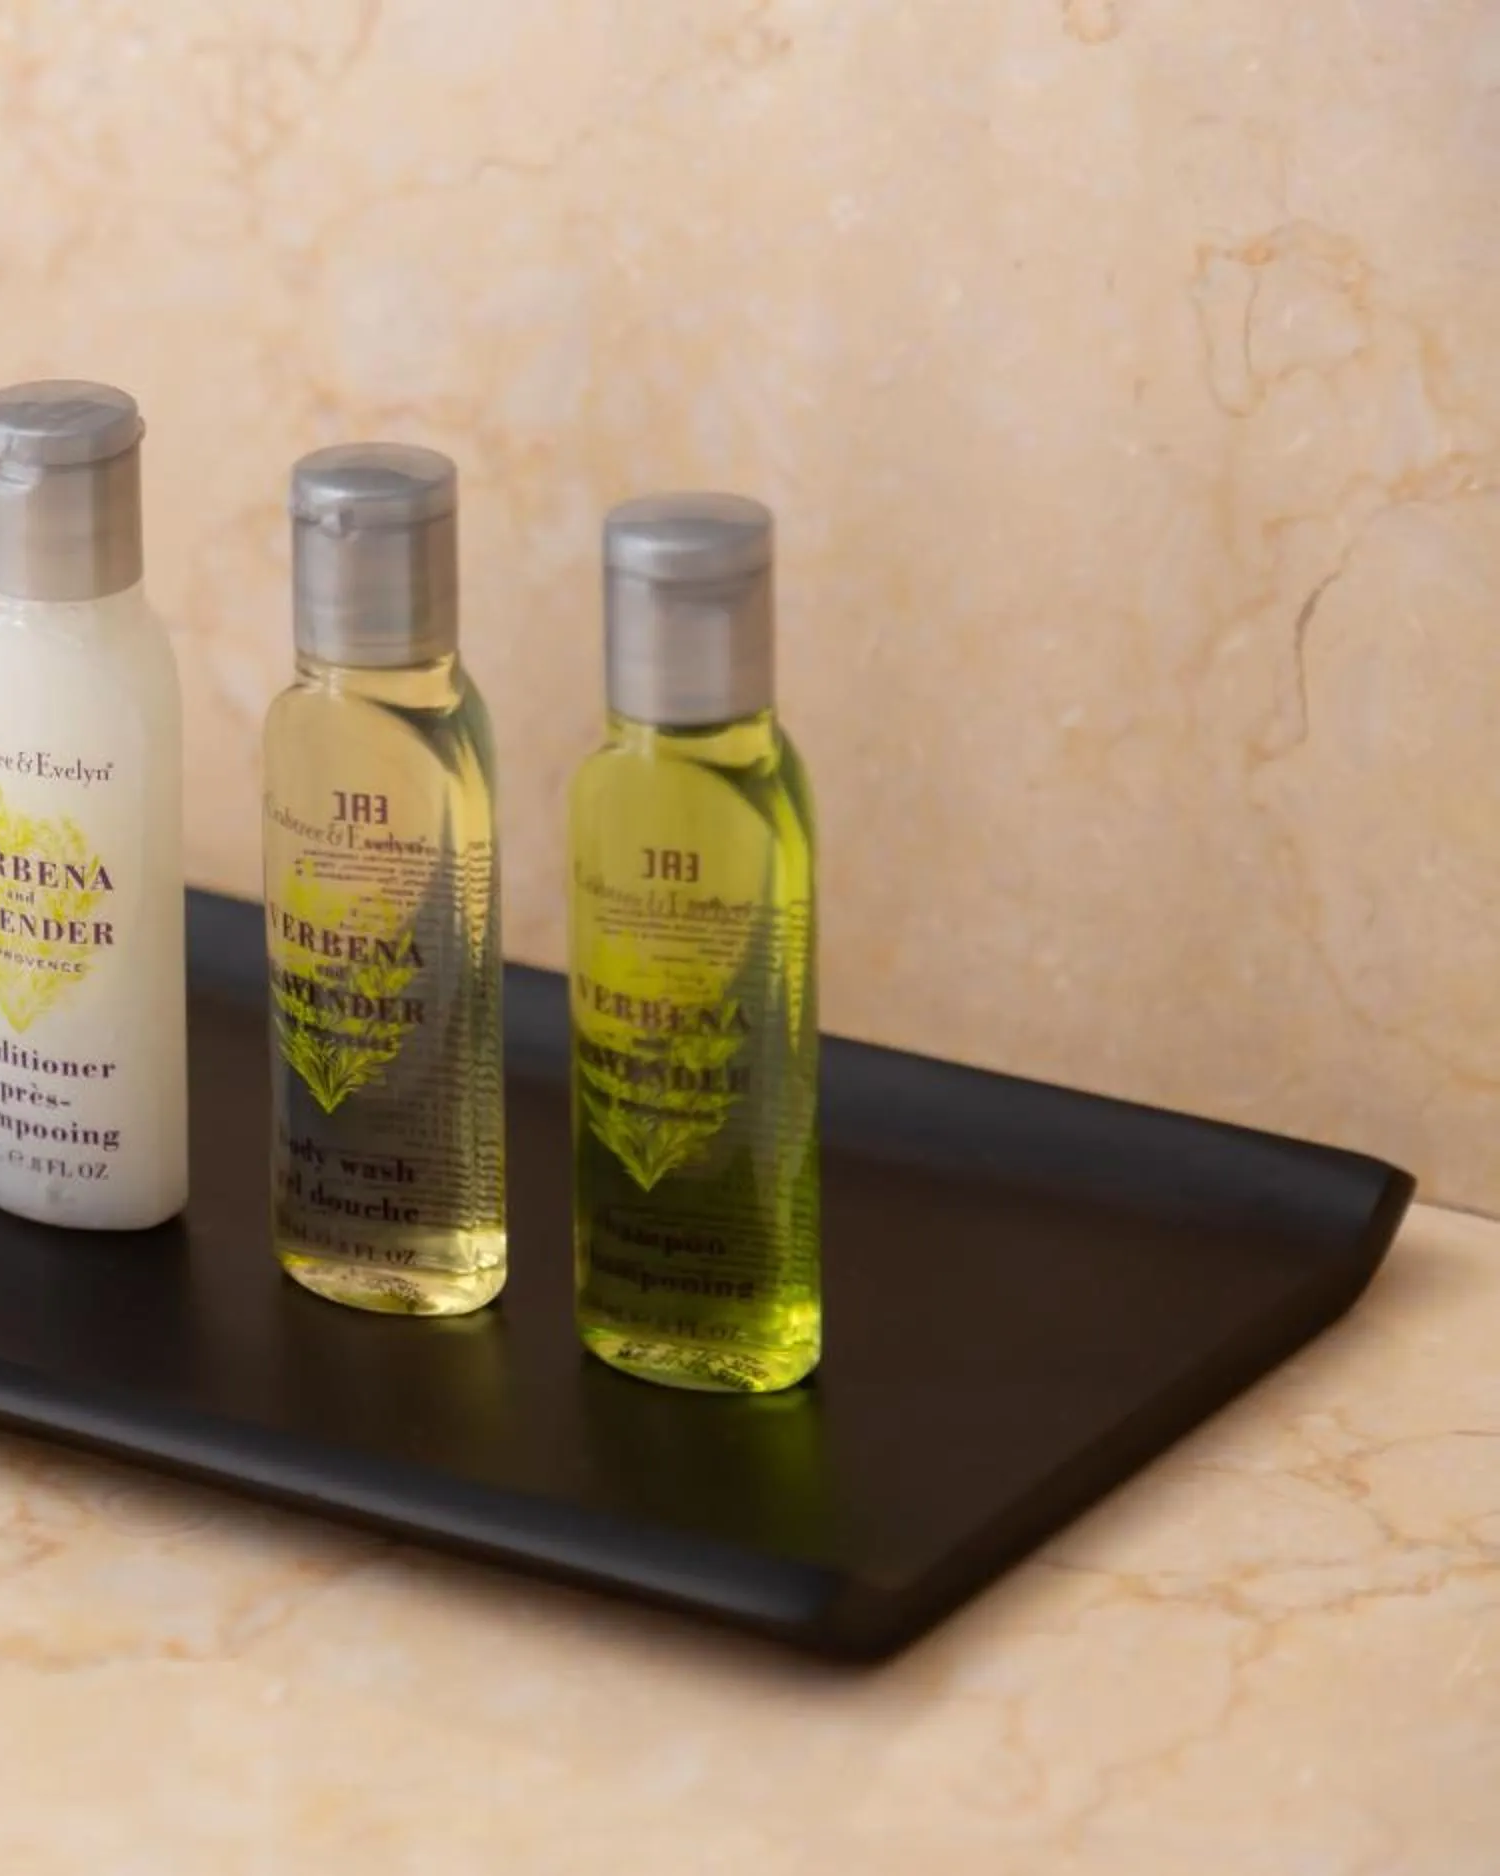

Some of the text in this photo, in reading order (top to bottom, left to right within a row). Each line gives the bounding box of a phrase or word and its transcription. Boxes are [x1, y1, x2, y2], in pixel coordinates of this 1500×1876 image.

[7, 889, 35, 905] and
[269, 901, 425, 969] VERBENA
[340, 1158, 415, 1184] wash
[309, 1180, 421, 1224] douche
